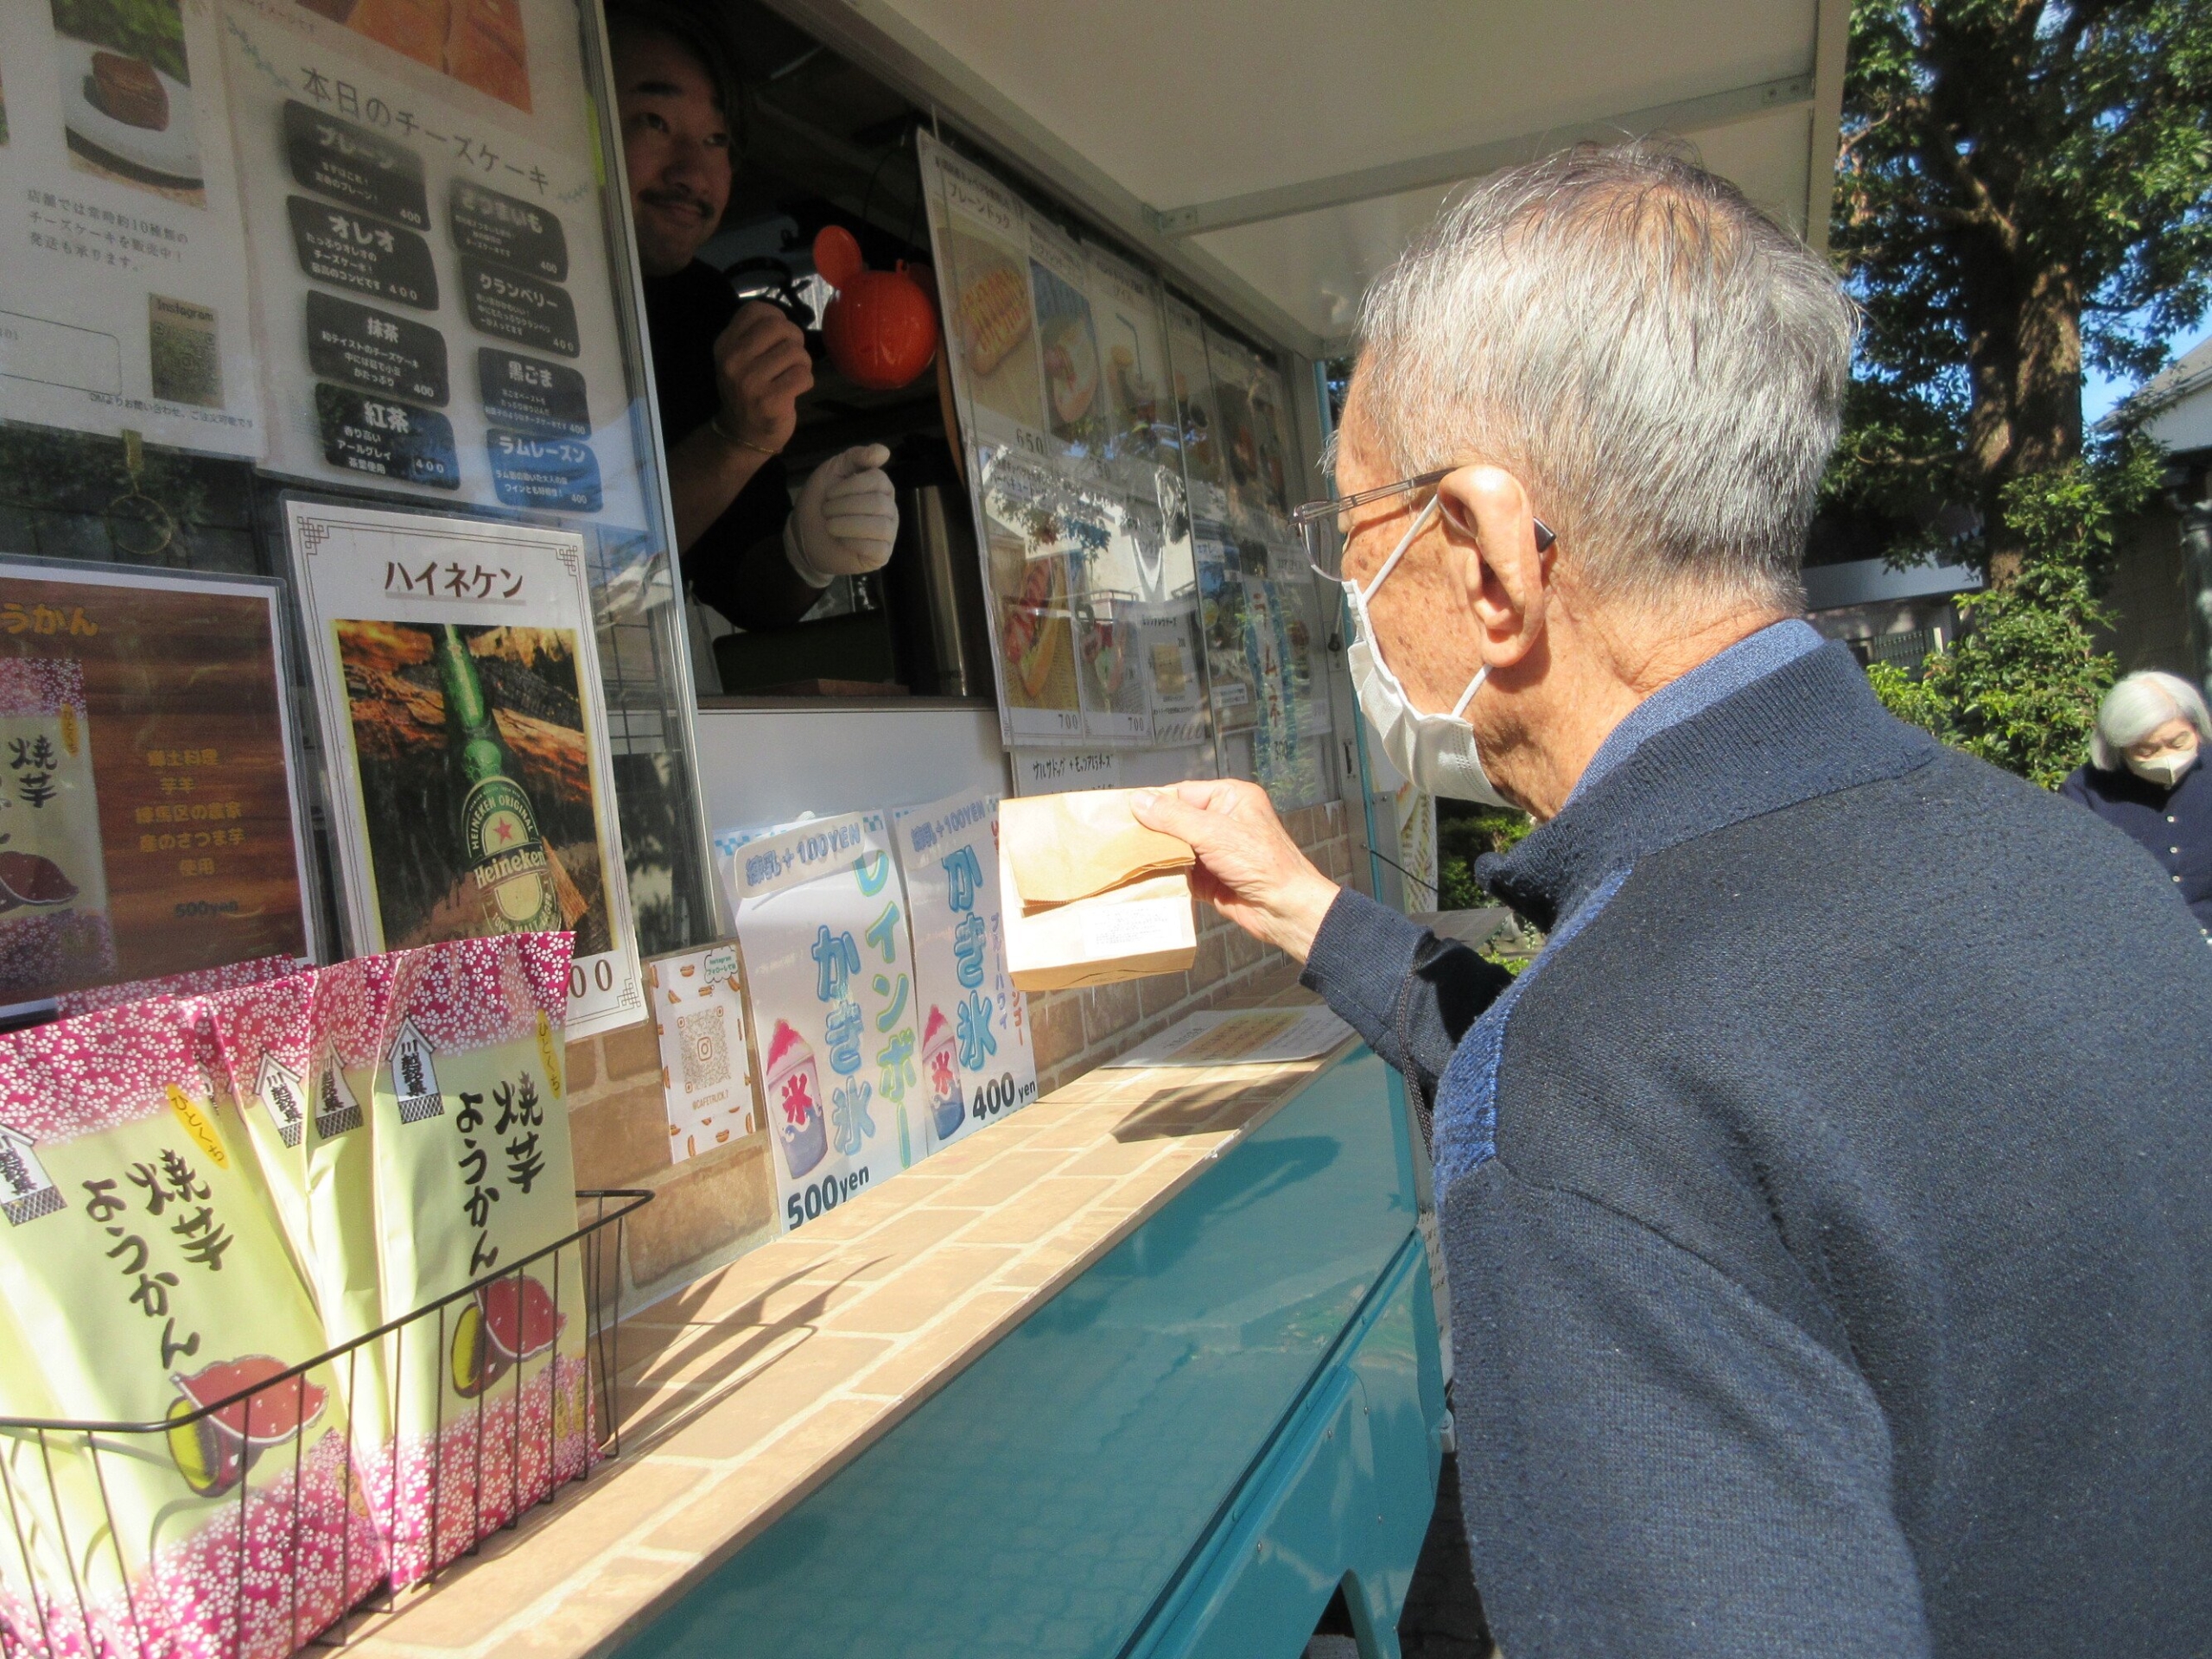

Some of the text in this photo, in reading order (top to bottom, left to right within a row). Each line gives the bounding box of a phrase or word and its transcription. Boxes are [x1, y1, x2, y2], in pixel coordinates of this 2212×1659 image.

[302, 67, 549, 195] 本日のチーズケーキ
[315, 123, 394, 172] プレーン
[327, 211, 395, 255] オレオ
[399, 207, 421, 225] 400
[305, 231, 377, 263] たっぷりオレオの
[539, 259, 557, 274] 400
[157, 300, 214, 321] Instagram
[479, 271, 559, 313] クランベリー
[365, 315, 399, 344] 抹茶
[412, 382, 434, 397] 400
[507, 359, 554, 389] 黒ごま
[343, 424, 381, 443] 香り高い
[362, 399, 410, 435] 紅茶
[569, 423, 586, 435] 400
[336, 439, 391, 461] アールグレイ
[498, 434, 586, 465] ラムレーズン
[1016, 428, 1044, 455] 650
[347, 455, 385, 474] 茶葉使用
[415, 458, 444, 474] 400
[570, 493, 587, 504] 400
[385, 562, 523, 599] ハイネケン
[1254, 593, 1280, 728] ラムネ
[1058, 714, 1078, 729] 700
[1128, 716, 1144, 731] 700
[9, 735, 58, 808] 焼芋
[470, 797, 497, 850] HEINEKEN
[499, 794, 534, 832] ORIGINAL
[474, 849, 547, 889] Heineken
[941, 844, 997, 1071] かき氷
[990, 912, 1007, 1030] ブルーハワイ
[852, 849, 917, 1170] レインボー
[538, 1021, 562, 1092] ひとくち
[811, 925, 876, 1156] かき氷
[931, 1051, 954, 1095] 氷
[781, 1072, 814, 1126] 氷
[972, 1071, 1037, 1121] 400 yen
[171, 1095, 226, 1161] ひとくち
[493, 1071, 546, 1194] 焼芋
[456, 1092, 500, 1277] ようかん
[125, 1148, 234, 1272] 焼芋
[82, 1178, 201, 1370] ようかん
